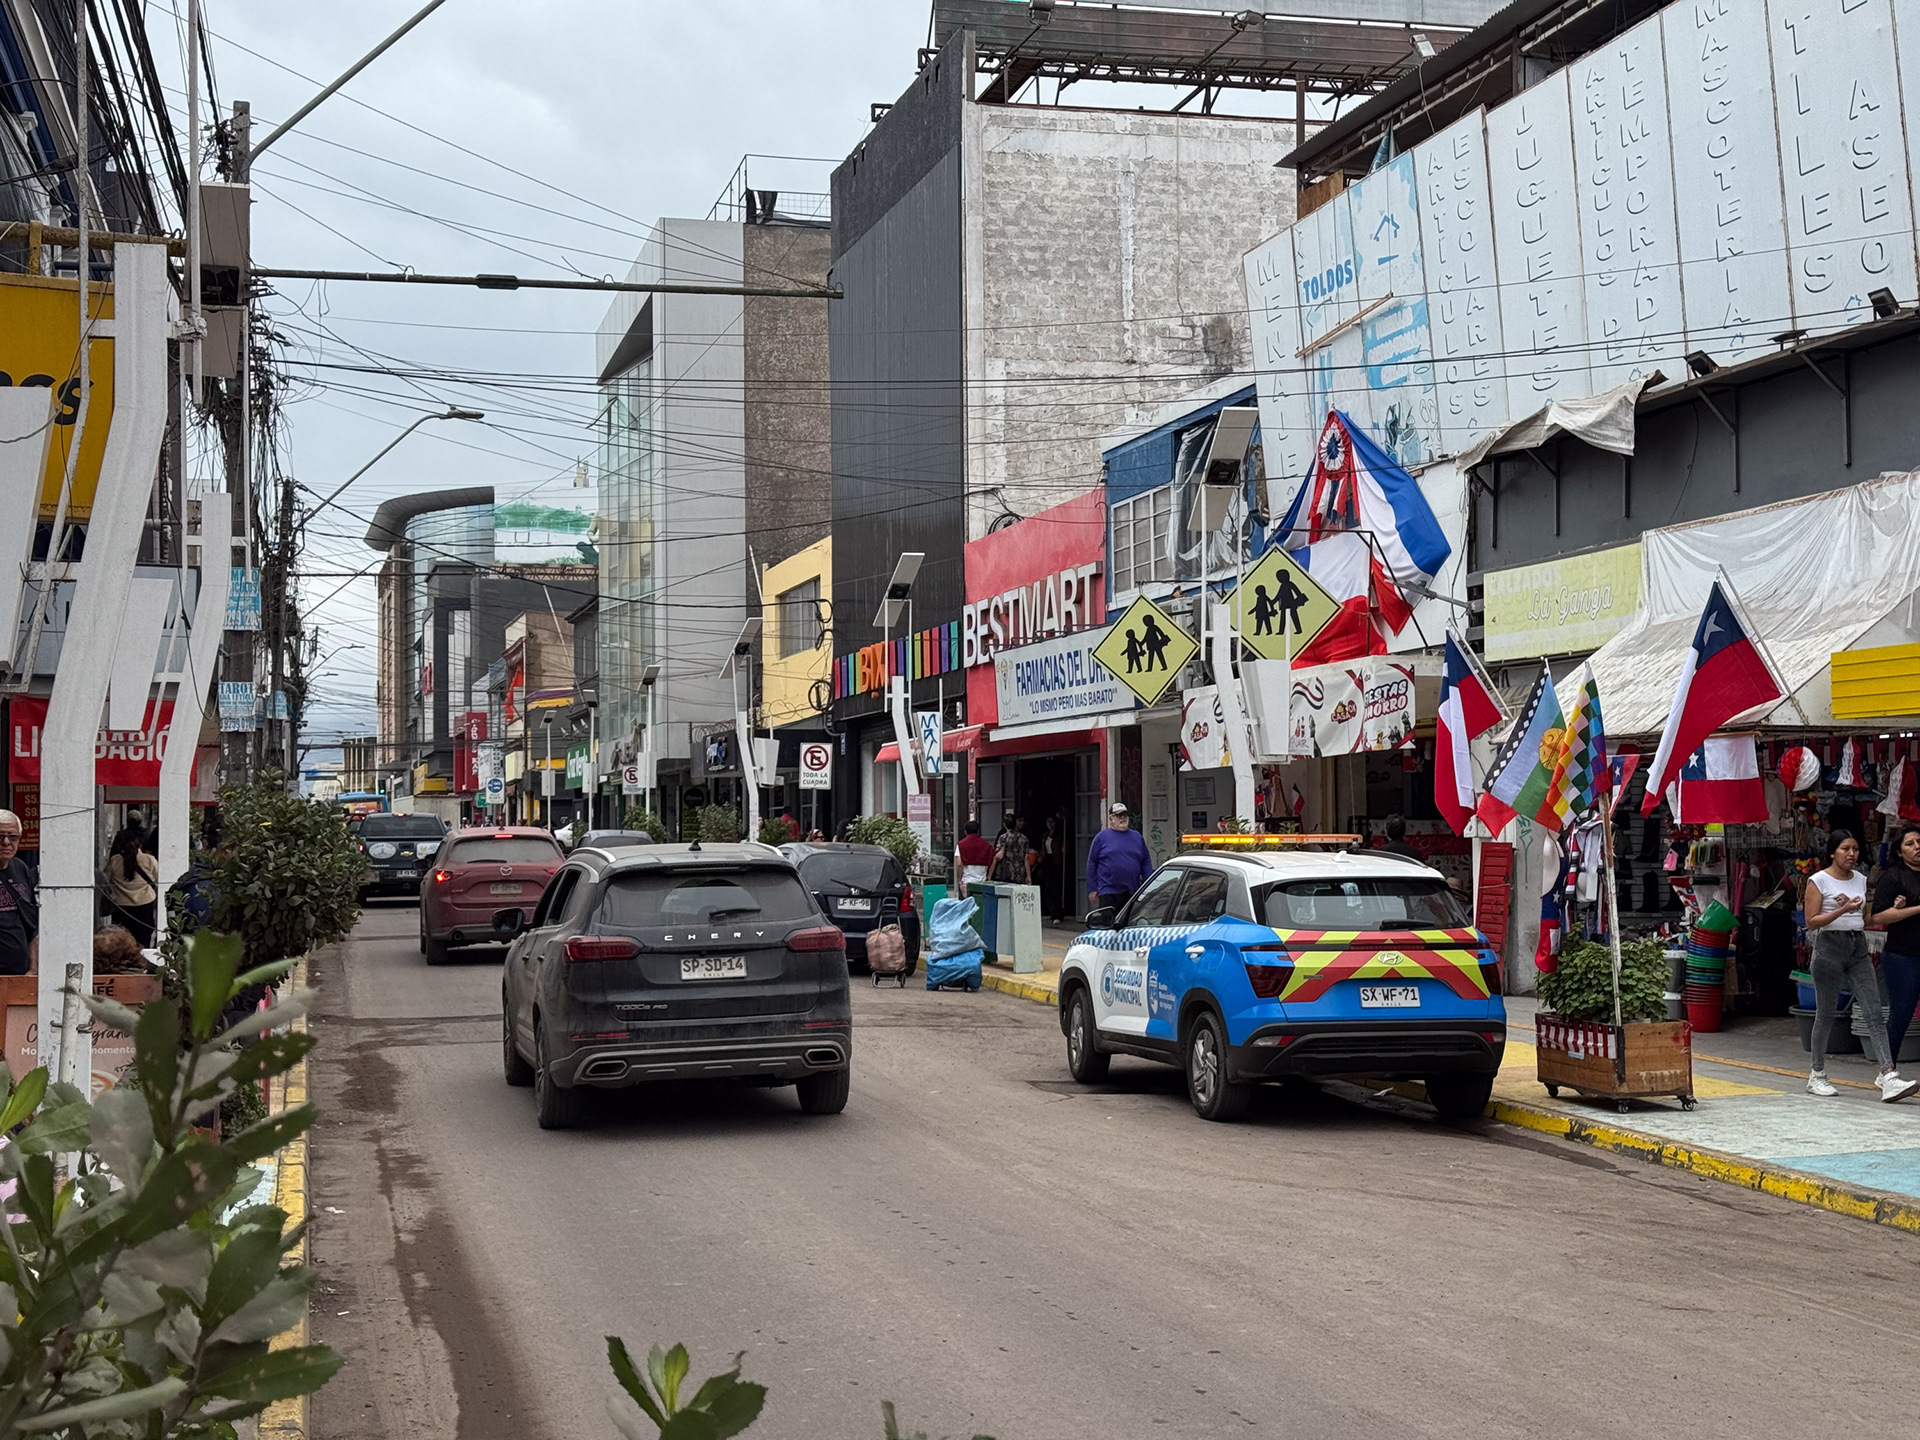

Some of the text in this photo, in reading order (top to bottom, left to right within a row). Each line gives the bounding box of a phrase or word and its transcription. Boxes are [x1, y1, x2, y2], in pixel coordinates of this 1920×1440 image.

[1848, 79, 1891, 274] ASEO
[1516, 103, 1560, 392] JUGUETES
[1302, 258, 1354, 304] TOLDOS
[1490, 565, 1561, 596] CALZADOS
[963, 561, 1100, 669] BESTMART
[1528, 584, 1614, 627] La Ganga
[220, 682, 253, 694] TAROT
[1015, 653, 1065, 697] FARMACIAS
[1066, 650, 1087, 688] DEL
[1040, 698, 1058, 713] MISMO
[1058, 695, 1074, 711] PERO
[1075, 692, 1088, 707] MAS
[664, 930, 764, 941] CHERY
[1114, 967, 1143, 989] SEGURIDAD
[1114, 988, 1142, 1007] MUNICIPAL
